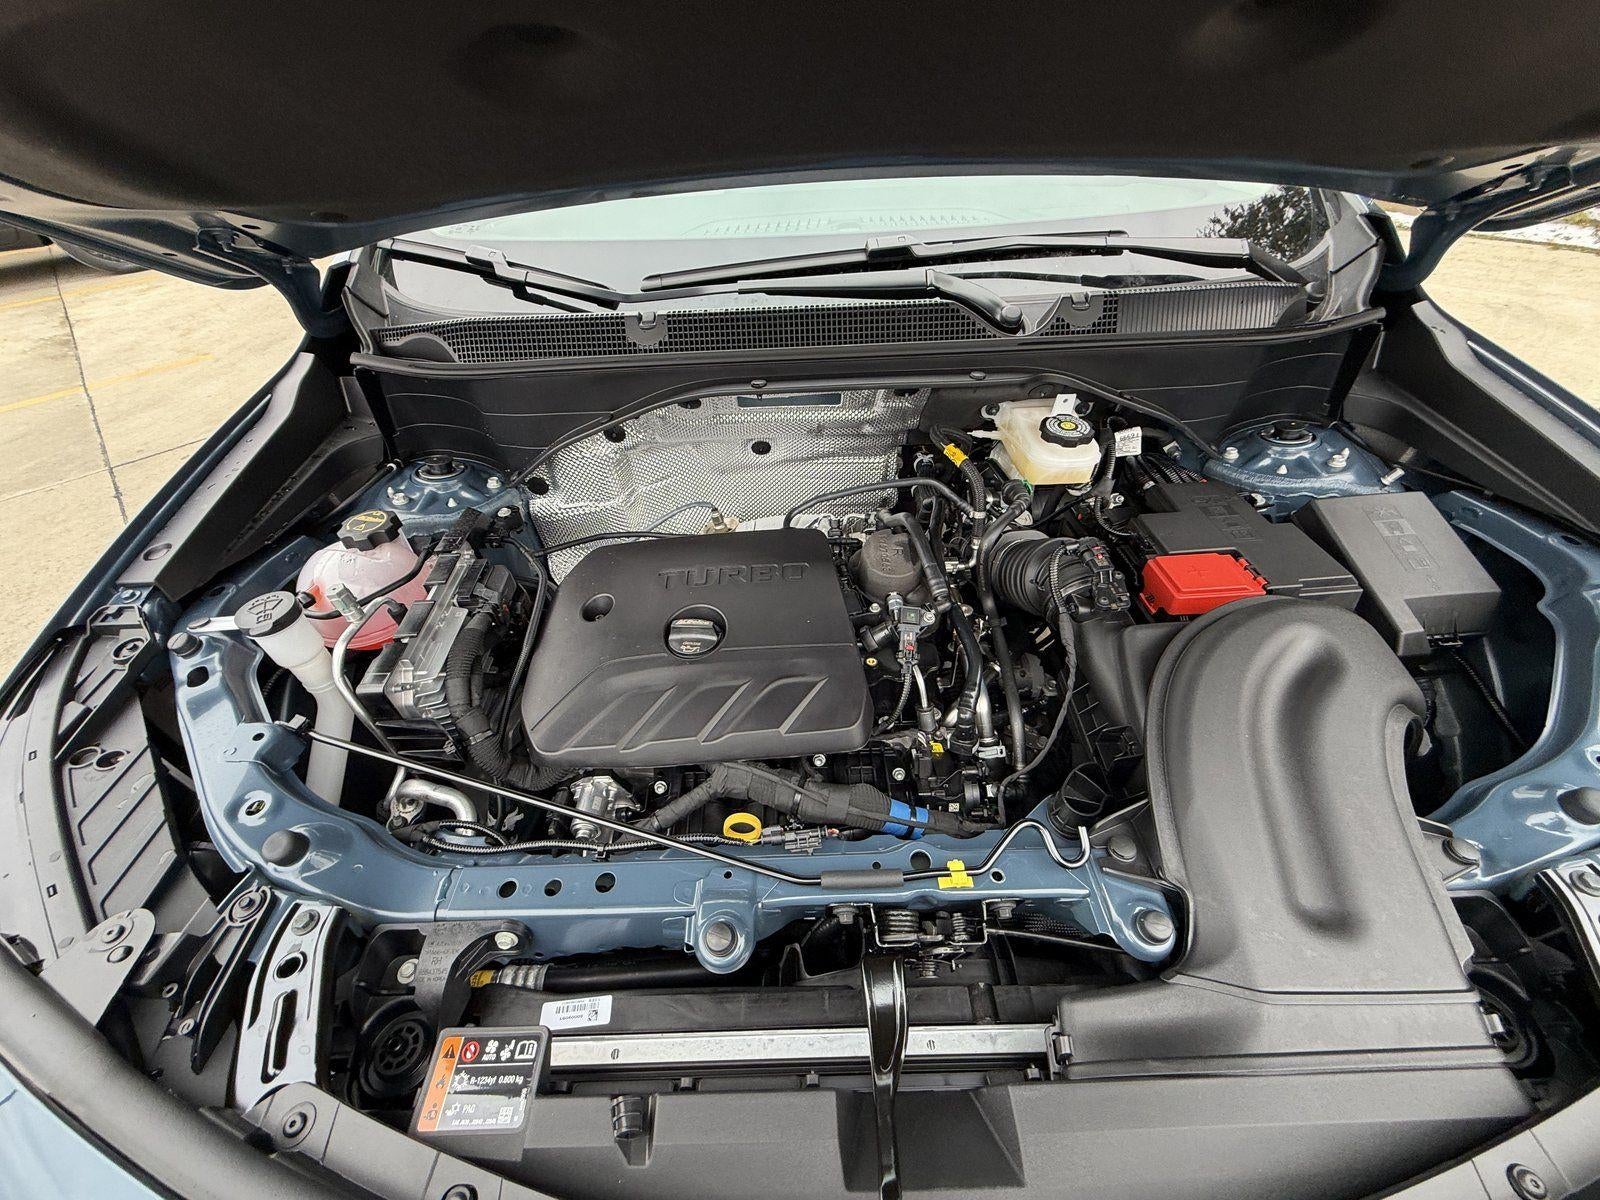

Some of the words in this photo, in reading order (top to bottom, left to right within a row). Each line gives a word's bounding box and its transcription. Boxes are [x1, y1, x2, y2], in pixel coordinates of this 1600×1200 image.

[657, 562, 811, 589] TURBO
[481, 1053, 497, 1061] AUTO
[469, 1076, 497, 1086] R-1234yf
[515, 1075, 524, 1085] kg
[462, 1103, 476, 1113] PAG
